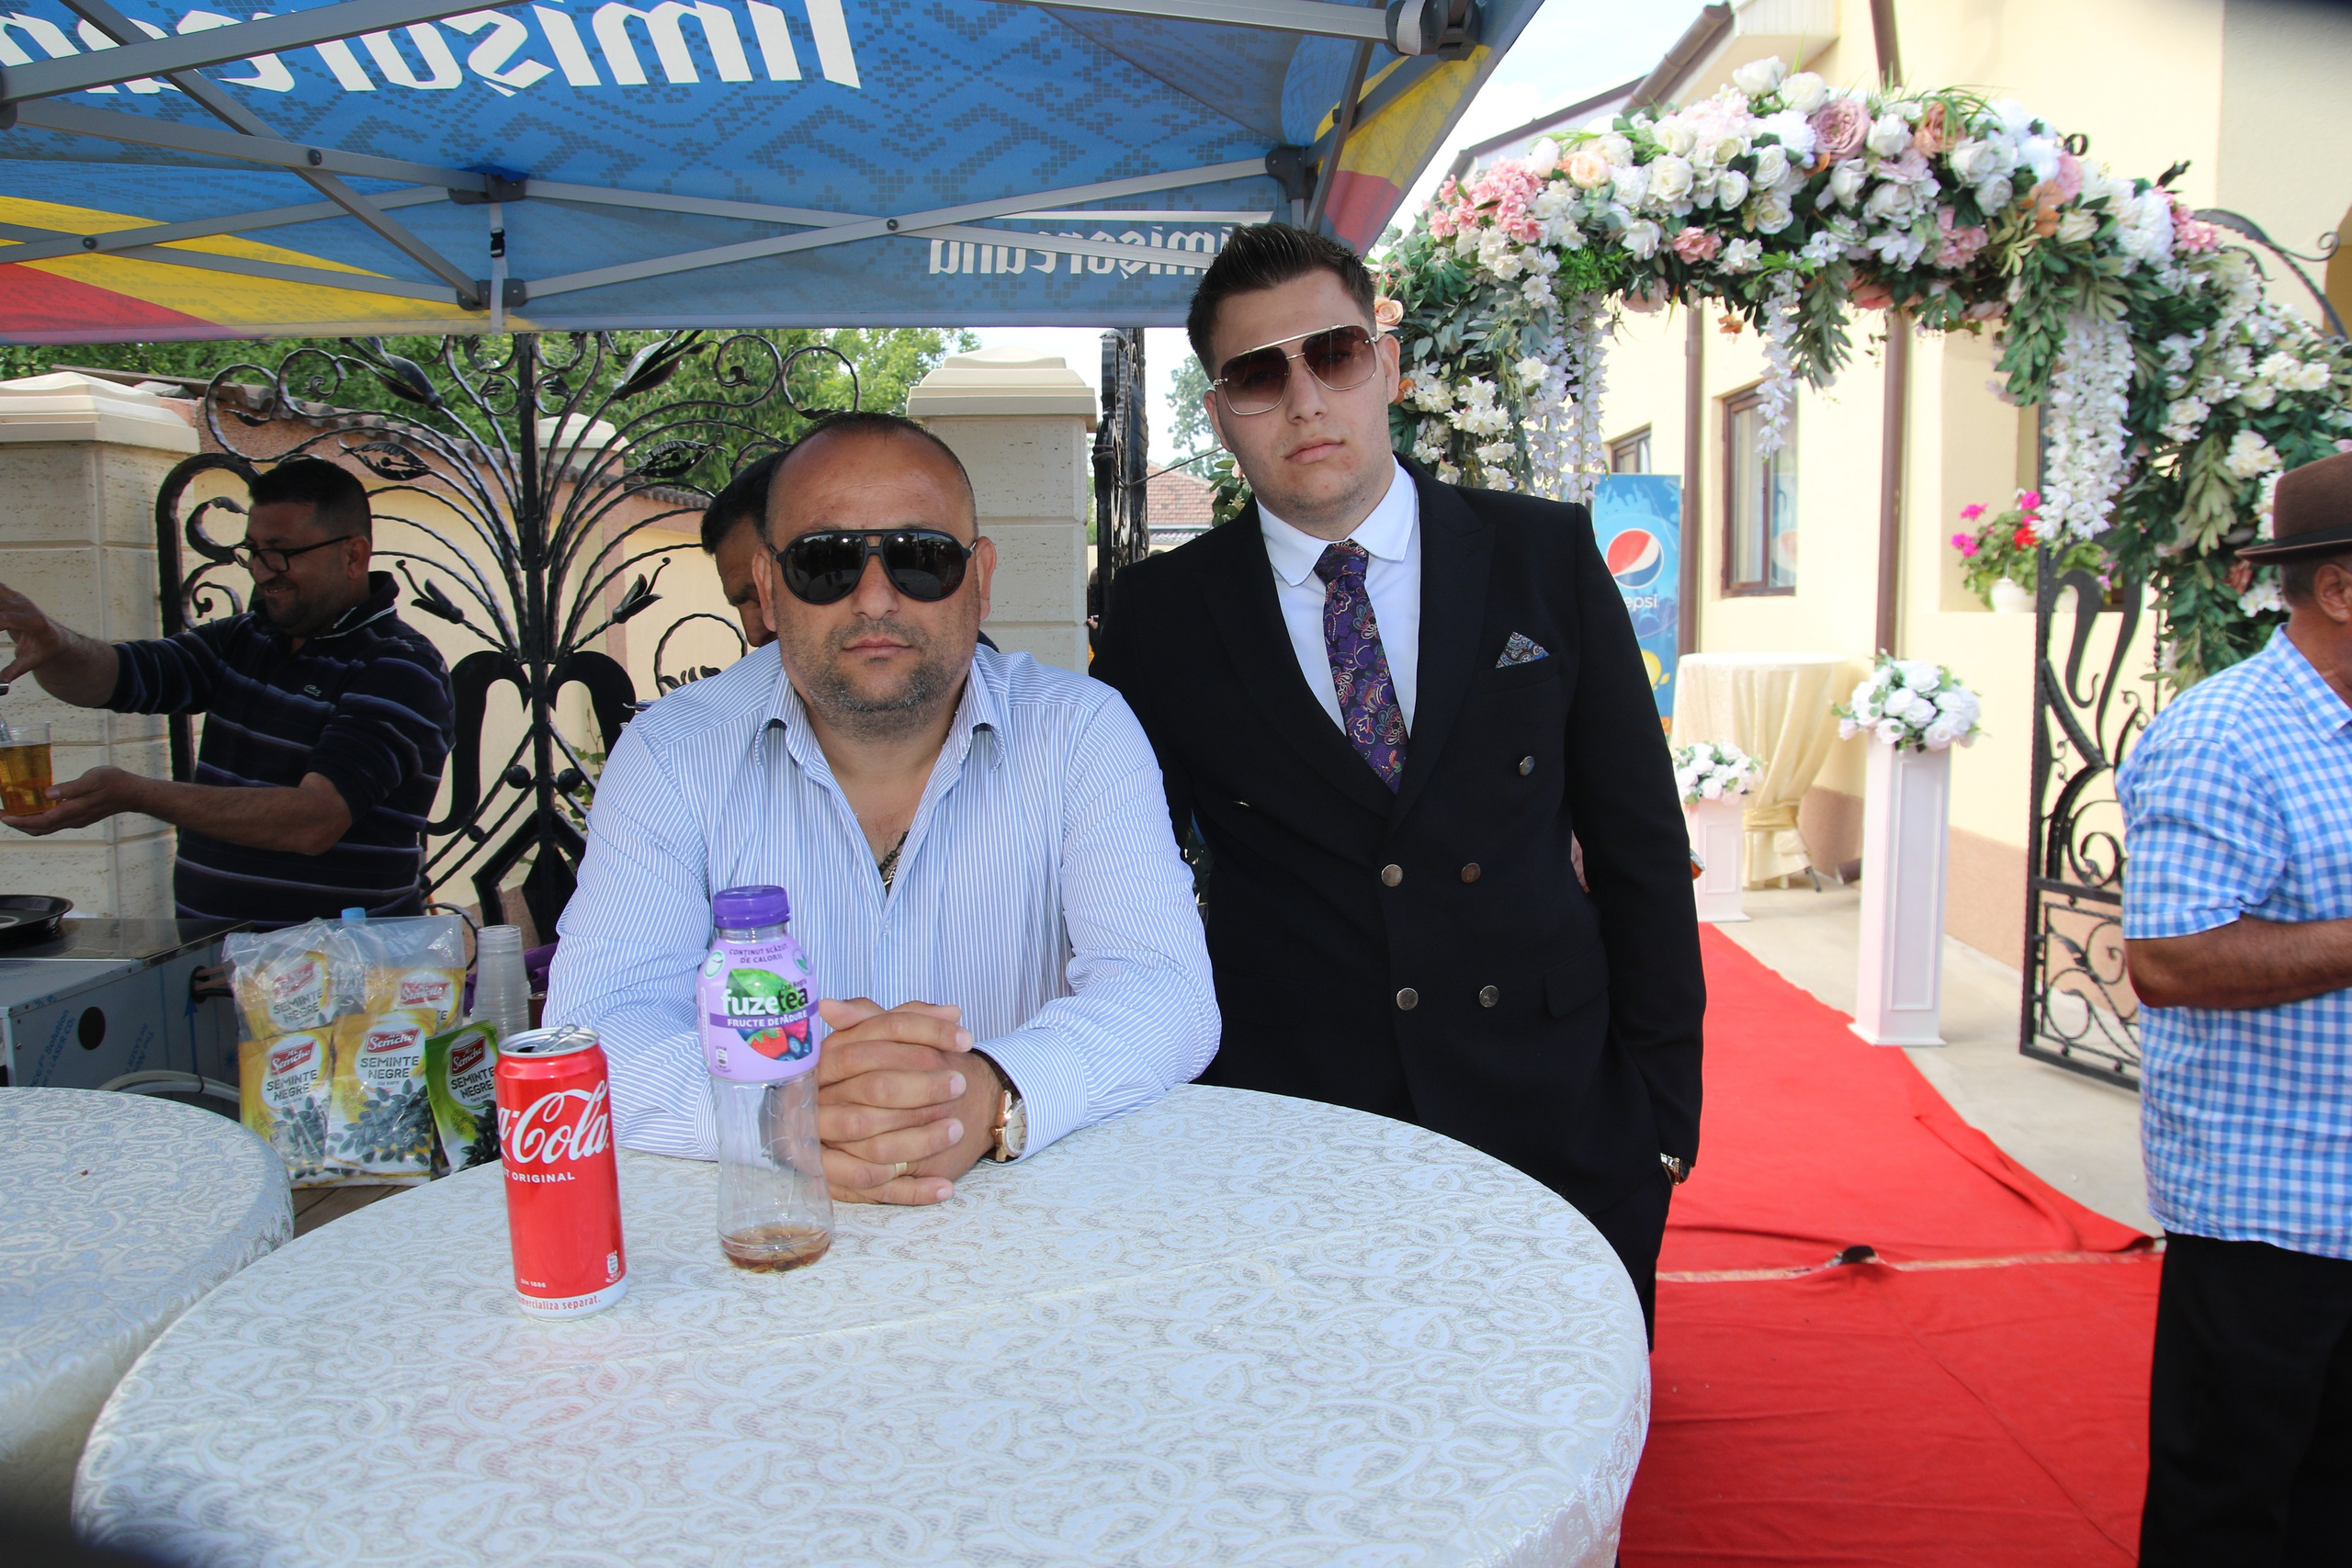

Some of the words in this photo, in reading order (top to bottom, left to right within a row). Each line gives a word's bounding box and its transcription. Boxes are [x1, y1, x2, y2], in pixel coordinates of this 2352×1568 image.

[1625, 594, 1657, 613] epsi
[727, 1018, 765, 1028] FRUCTE
[368, 1033, 413, 1051] Semcho
[360, 1055, 420, 1068] SEMINTE
[368, 1067, 410, 1079] NEGRE
[450, 1066, 494, 1090] SEMINTE
[274, 1083, 311, 1101] NEGRE
[460, 1079, 494, 1099] NEGRE
[498, 1079, 609, 1165] a-Cola
[512, 1171, 575, 1184] ORIGINAL
[562, 1294, 602, 1311] separat.
